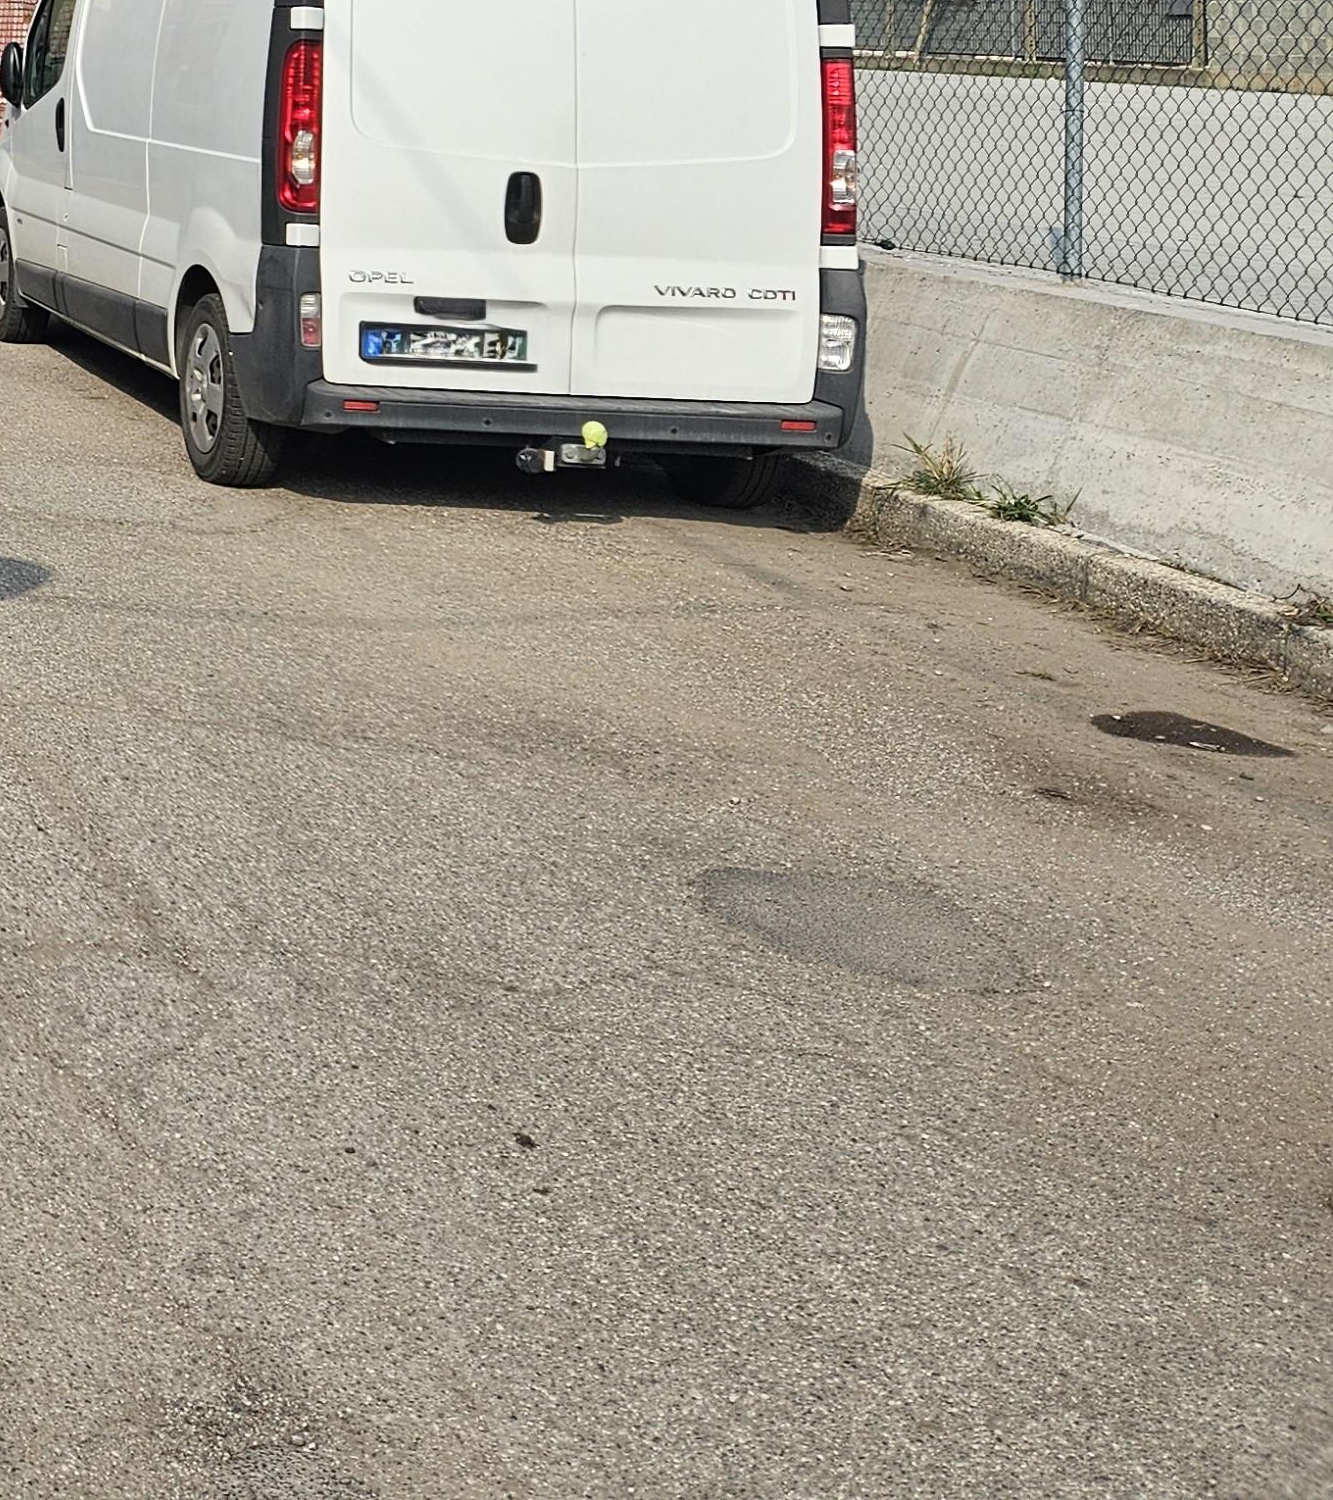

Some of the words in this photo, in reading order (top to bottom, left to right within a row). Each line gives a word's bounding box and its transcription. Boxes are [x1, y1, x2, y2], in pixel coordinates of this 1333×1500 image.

[348, 269, 414, 285] OPEL
[653, 284, 737, 299] VIVARO
[747, 288, 797, 302] CDTI
